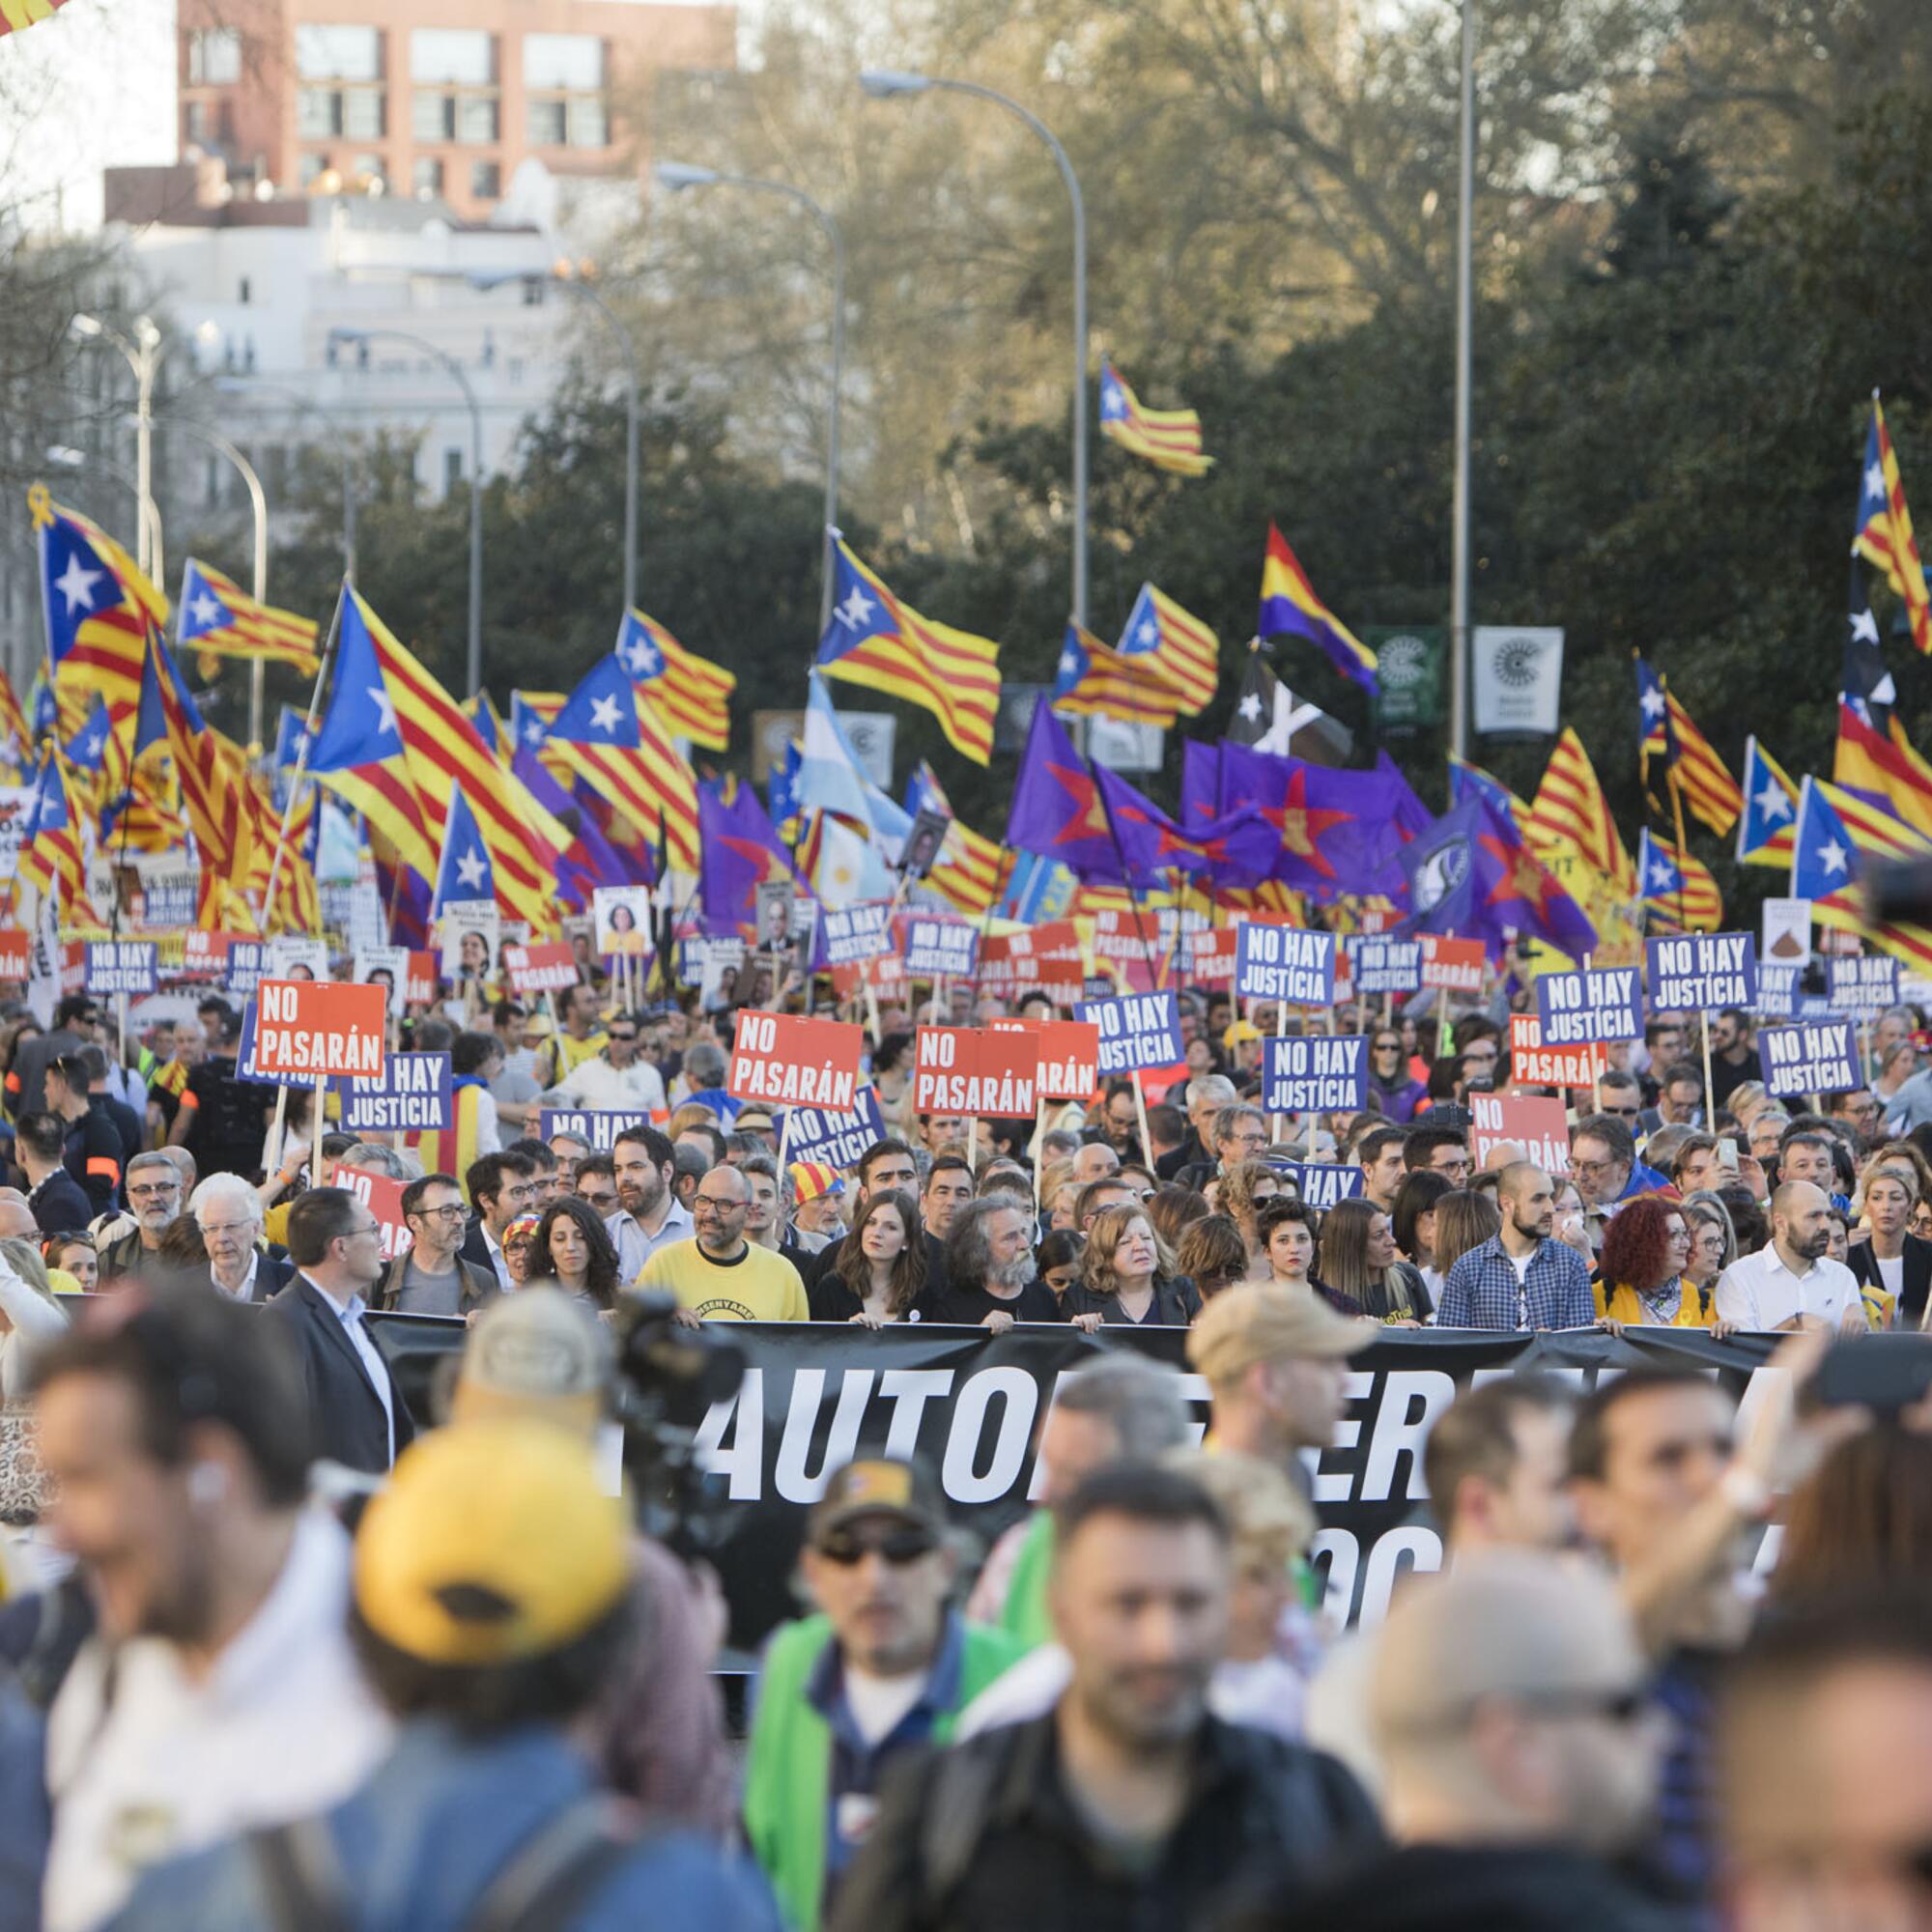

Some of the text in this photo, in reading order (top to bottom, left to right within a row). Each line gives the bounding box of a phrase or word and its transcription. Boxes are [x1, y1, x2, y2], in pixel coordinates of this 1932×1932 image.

[91, 946, 117, 968] NO
[119, 946, 155, 968] HAY
[1248, 926, 1279, 963] NO
[1285, 931, 1329, 970] HAY
[1659, 937, 1747, 976] NO HAY
[1240, 964, 1325, 1002] JUSTÍCIA
[1832, 956, 1894, 984] NO HAY
[263, 984, 298, 1023] NO
[1548, 970, 1634, 1010] NO HAY
[1655, 973, 1748, 1009] JUSTÍCIA
[739, 1015, 777, 1054] NO
[1084, 994, 1170, 1038] NO HAY
[1513, 1019, 1542, 1048] NO
[1546, 1006, 1636, 1043] JUSTÍCIA
[260, 1024, 380, 1071] PASARÁN
[920, 1032, 956, 1067] NO
[1096, 1033, 1177, 1073] USTÍCIA
[1274, 1039, 1361, 1076] NO HAY
[1767, 1024, 1848, 1065] NO HAY
[393, 1057, 444, 1093] HAY
[733, 1057, 854, 1107] PASARÁN
[918, 1068, 1034, 1114] PASARÁN
[1267, 1075, 1358, 1109] JUSTÍCIA
[1768, 1059, 1854, 1095] JUSTÍCIA
[347, 1093, 443, 1127] JUSTÍCIA
[1474, 1098, 1504, 1131] NO
[1303, 1169, 1357, 1208] HAY
